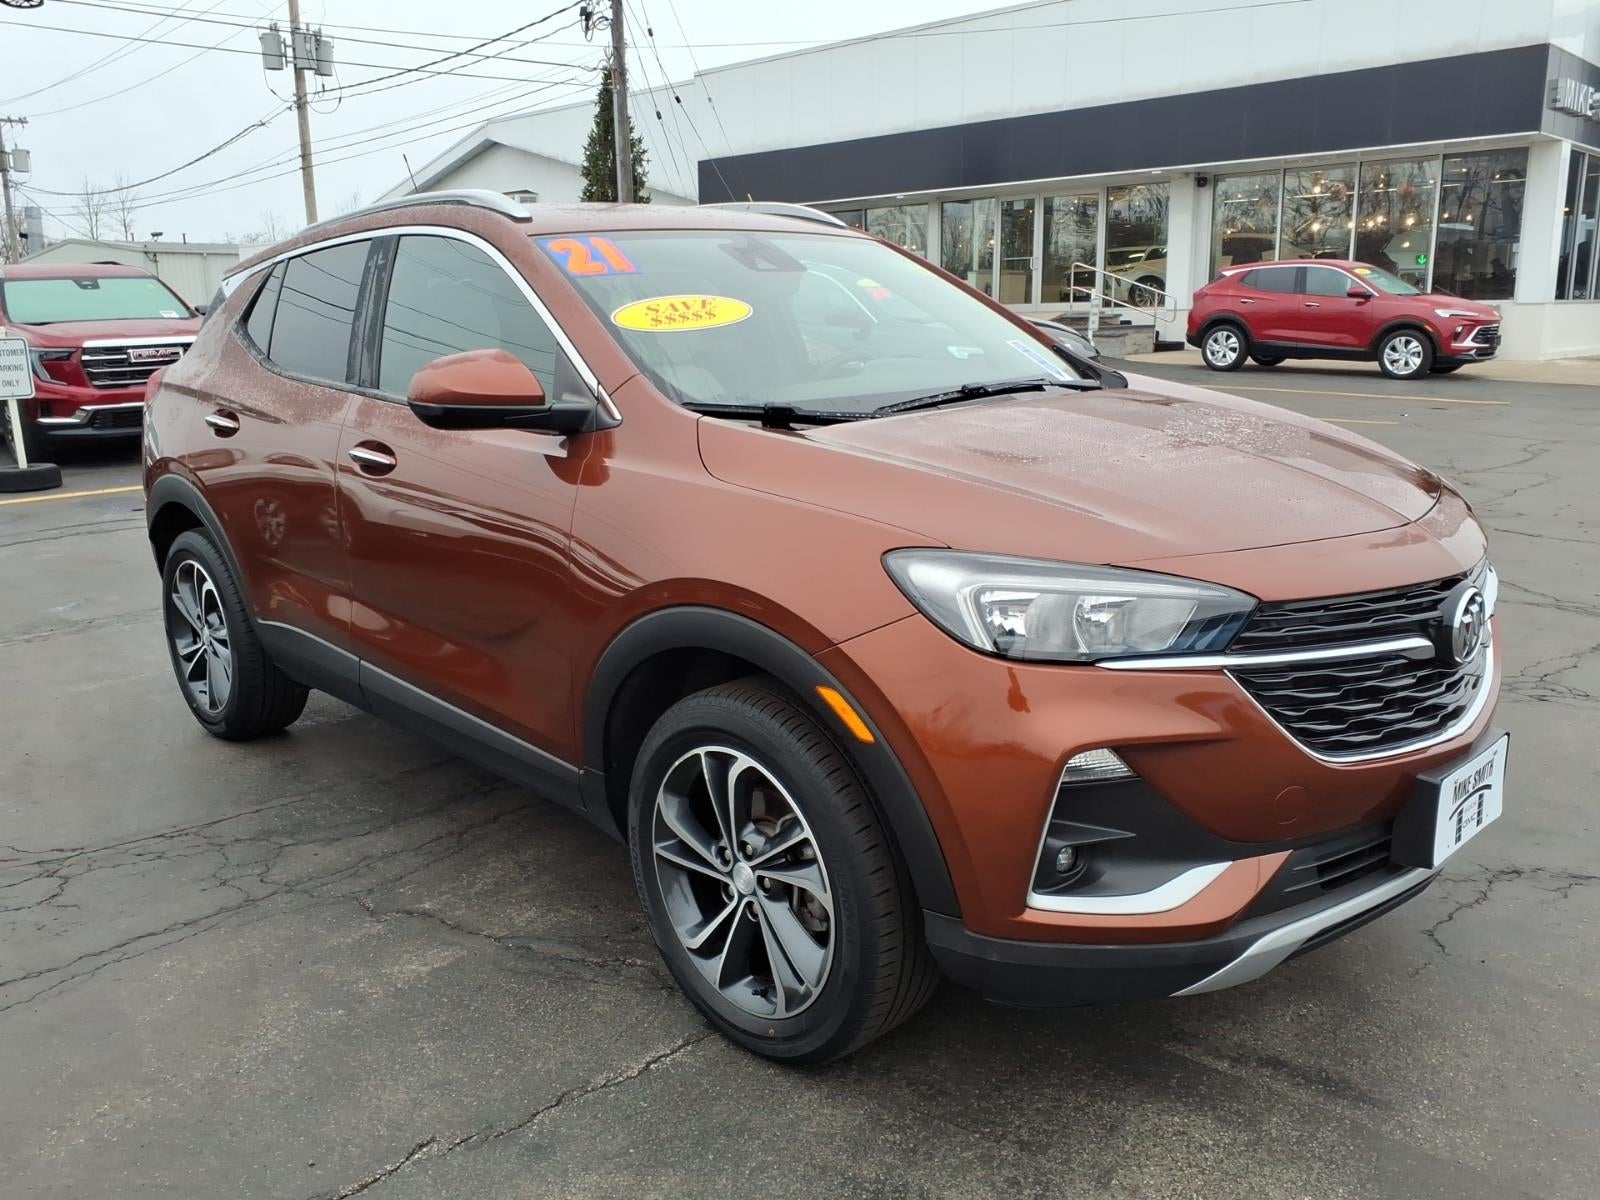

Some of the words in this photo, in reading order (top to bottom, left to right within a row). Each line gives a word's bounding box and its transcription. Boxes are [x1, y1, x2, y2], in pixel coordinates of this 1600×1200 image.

[1565, 77, 1595, 116] MIKE
[547, 236, 638, 276] 21
[645, 298, 717, 316] SAVE
[127, 346, 184, 362] GMC
[2, 379, 20, 387] ONLY
[1452, 774, 1473, 806] MIKE
[1472, 757, 1495, 790] SMITH
